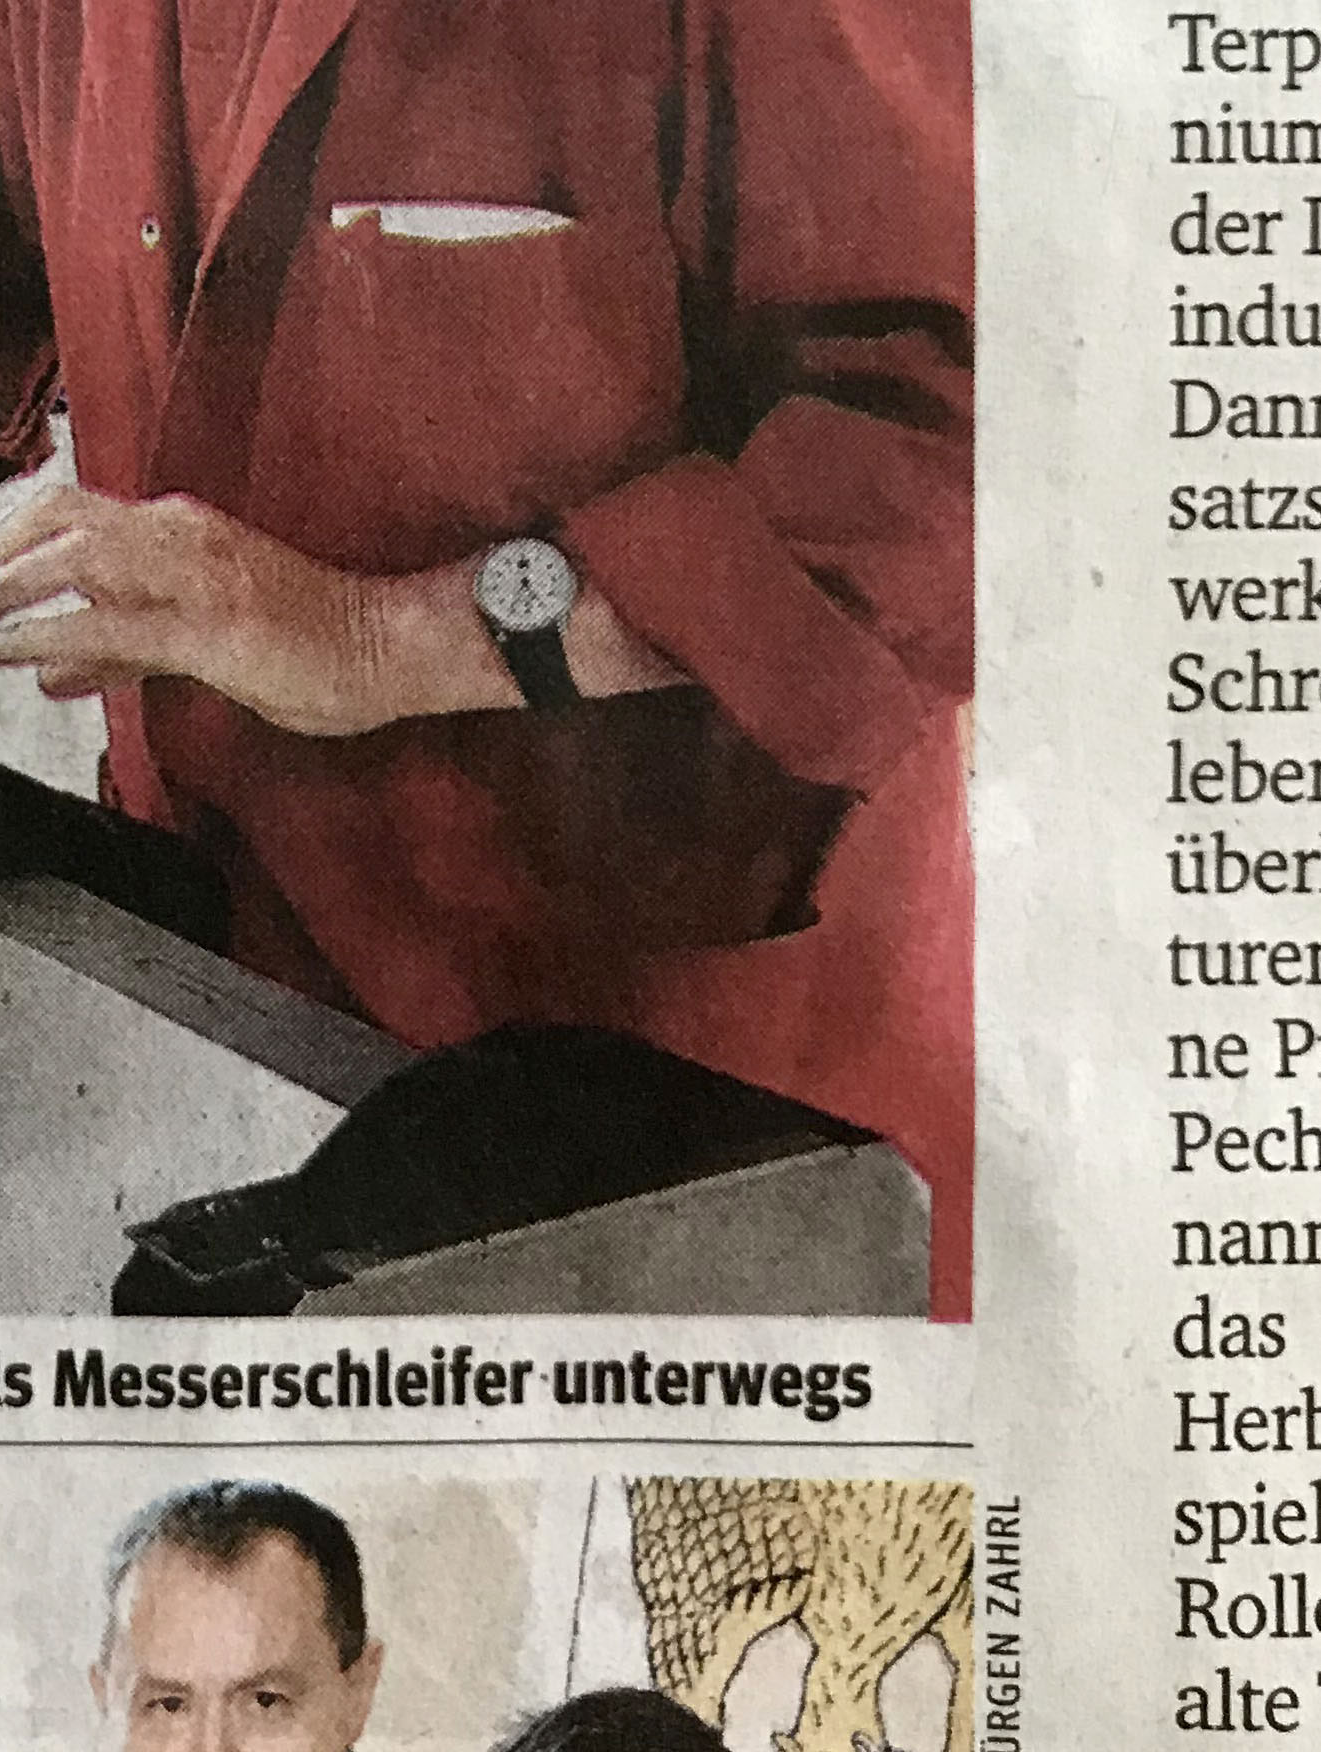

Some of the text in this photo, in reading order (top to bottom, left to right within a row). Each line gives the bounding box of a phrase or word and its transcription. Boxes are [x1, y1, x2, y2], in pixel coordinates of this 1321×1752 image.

[1167, 13, 1321, 92] Terp
[1169, 191, 1285, 257] der
[1169, 282, 1321, 349] indu
[1166, 1032, 1249, 1081] ne
[1168, 1105, 1321, 1174] Pech
[1172, 1293, 1286, 1361] das
[53, 1345, 527, 1409] Messerschleifer
[552, 1348, 872, 1423] unterwegs
[985, 1495, 1021, 1618] ZAHRL
[1174, 1665, 1300, 1734] alte
